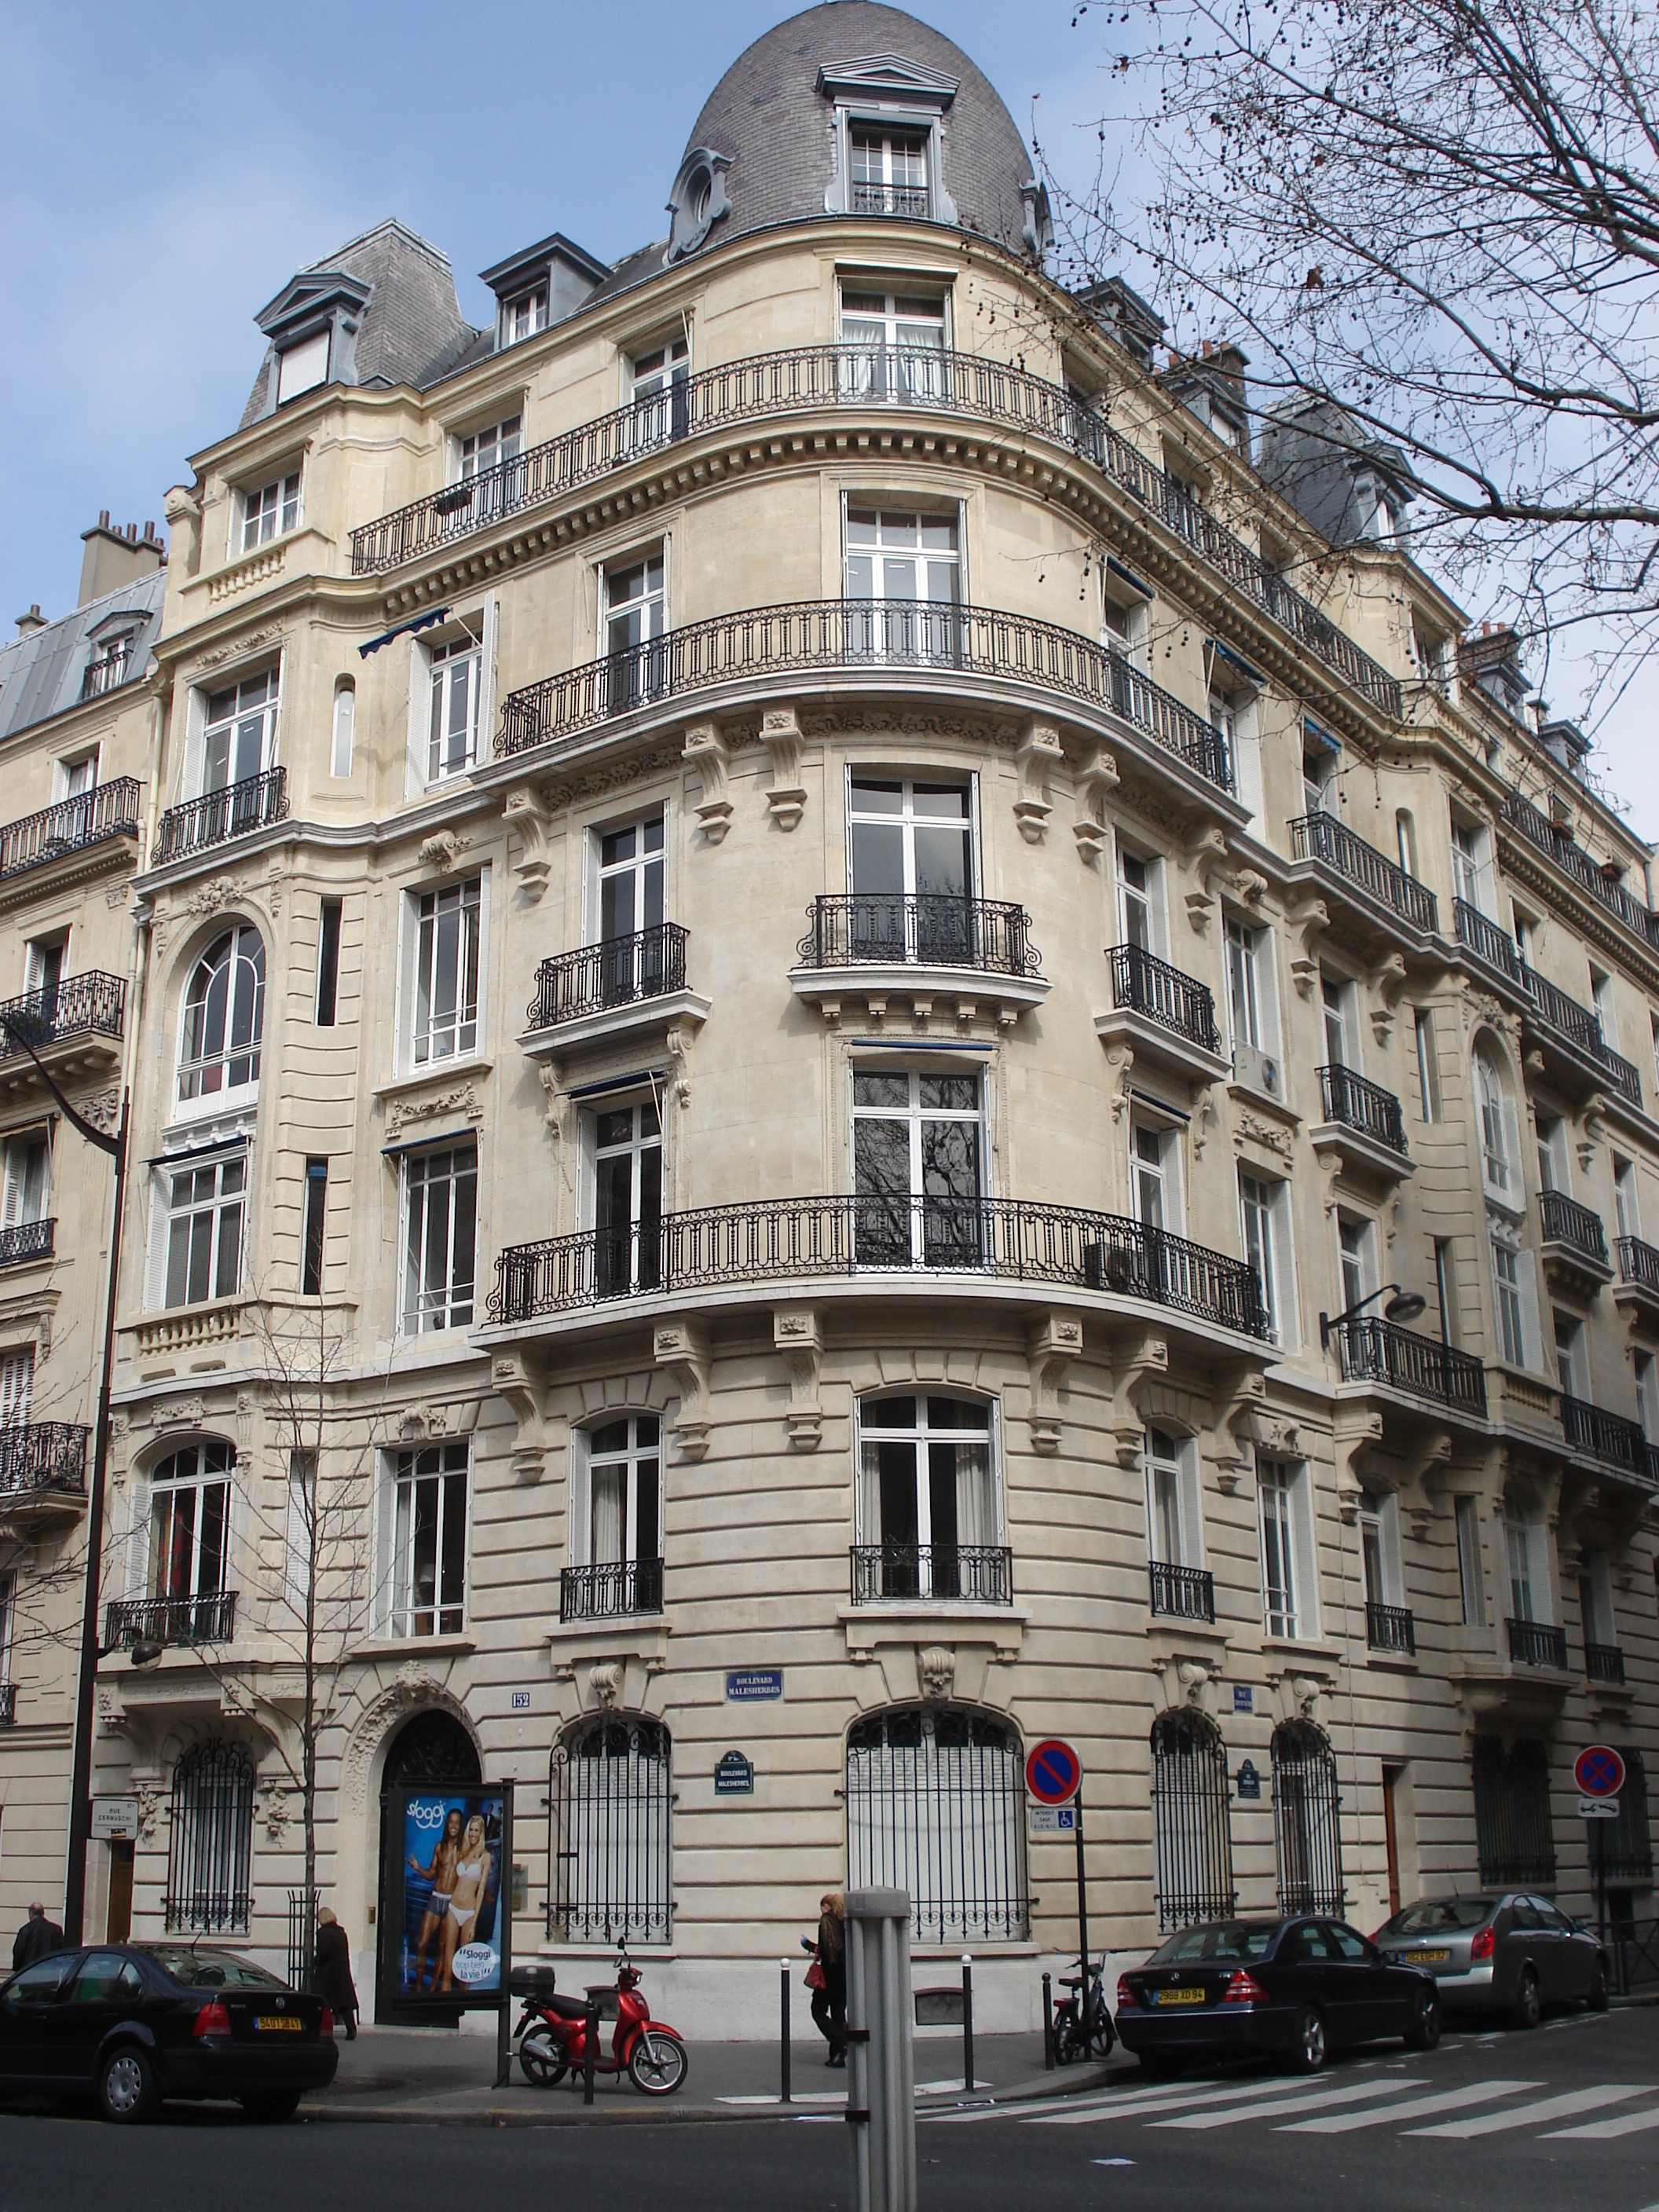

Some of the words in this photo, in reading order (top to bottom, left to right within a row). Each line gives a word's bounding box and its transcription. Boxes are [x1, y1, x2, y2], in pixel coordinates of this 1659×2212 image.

[736, 1676, 773, 1685] BOULEVARD
[728, 1686, 780, 1695] MALESHERBES
[513, 1694, 529, 1707] 152
[406, 1800, 445, 1829] sloggi
[456, 1961, 470, 1970] trop
